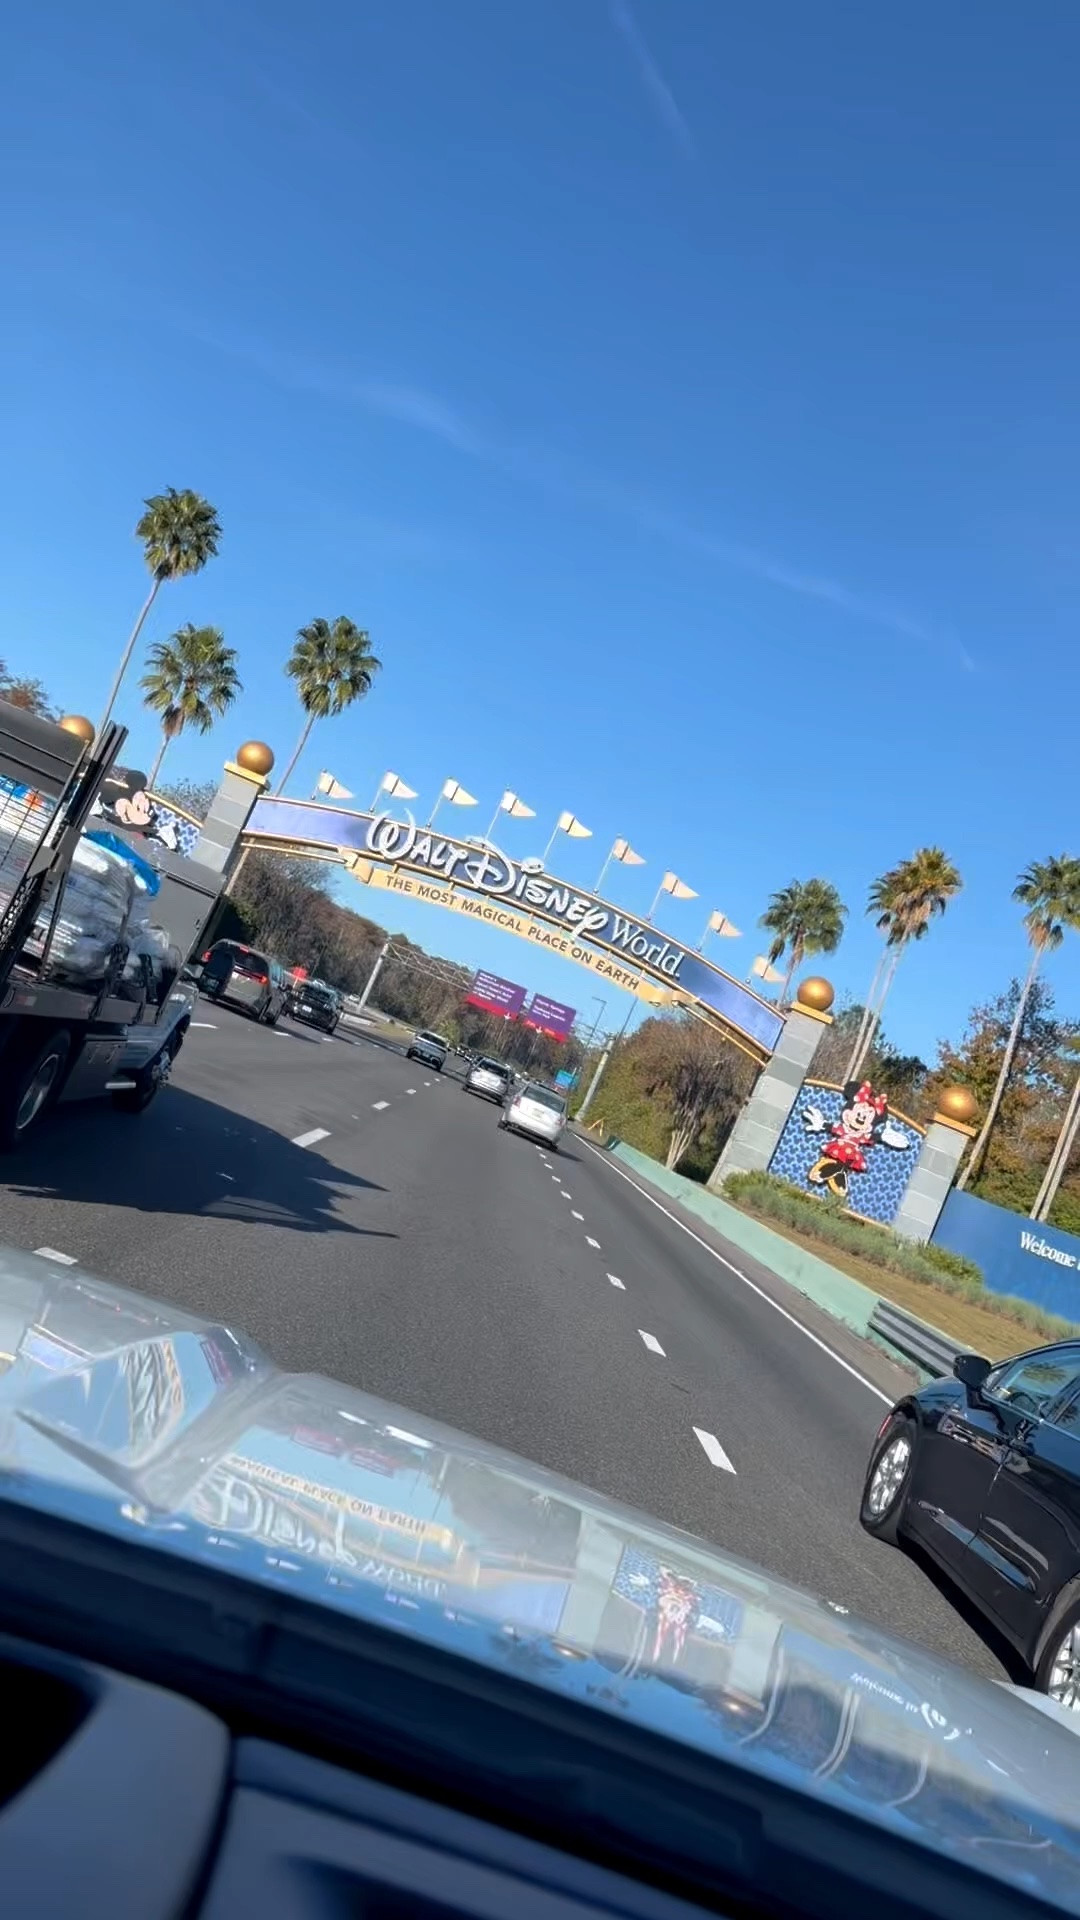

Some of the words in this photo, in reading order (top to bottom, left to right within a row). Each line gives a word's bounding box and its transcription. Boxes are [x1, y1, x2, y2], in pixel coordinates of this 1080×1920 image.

[366, 807, 468, 876] WALT
[464, 835, 609, 941] DISNEY
[386, 875, 413, 893] THE
[417, 885, 459, 906] MOST
[461, 899, 522, 932] MAGICAL
[528, 926, 569, 952] PLACE
[571, 946, 593, 963] ON
[595, 960, 640, 991] EARTH
[1020, 1230, 1077, 1268] Welcome
